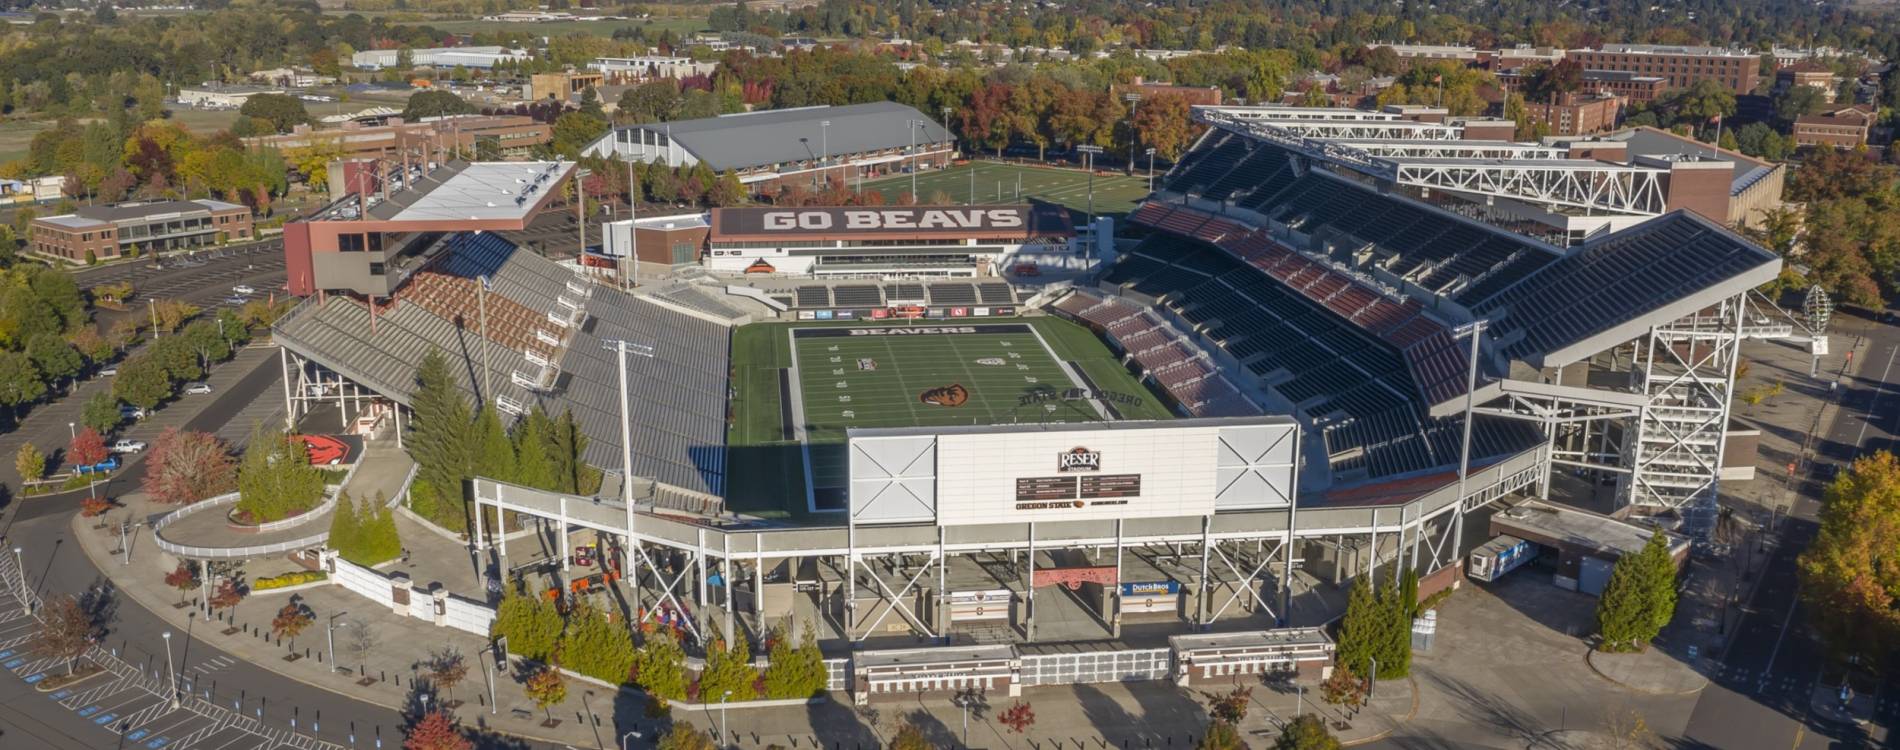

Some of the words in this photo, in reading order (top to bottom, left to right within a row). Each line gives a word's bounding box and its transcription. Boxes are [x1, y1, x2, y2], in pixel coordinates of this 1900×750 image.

[763, 211, 833, 230] GO
[845, 209, 1023, 229] BEAVS
[849, 327, 976, 335] BEAVERS
[1061, 453, 1098, 467] RESER
